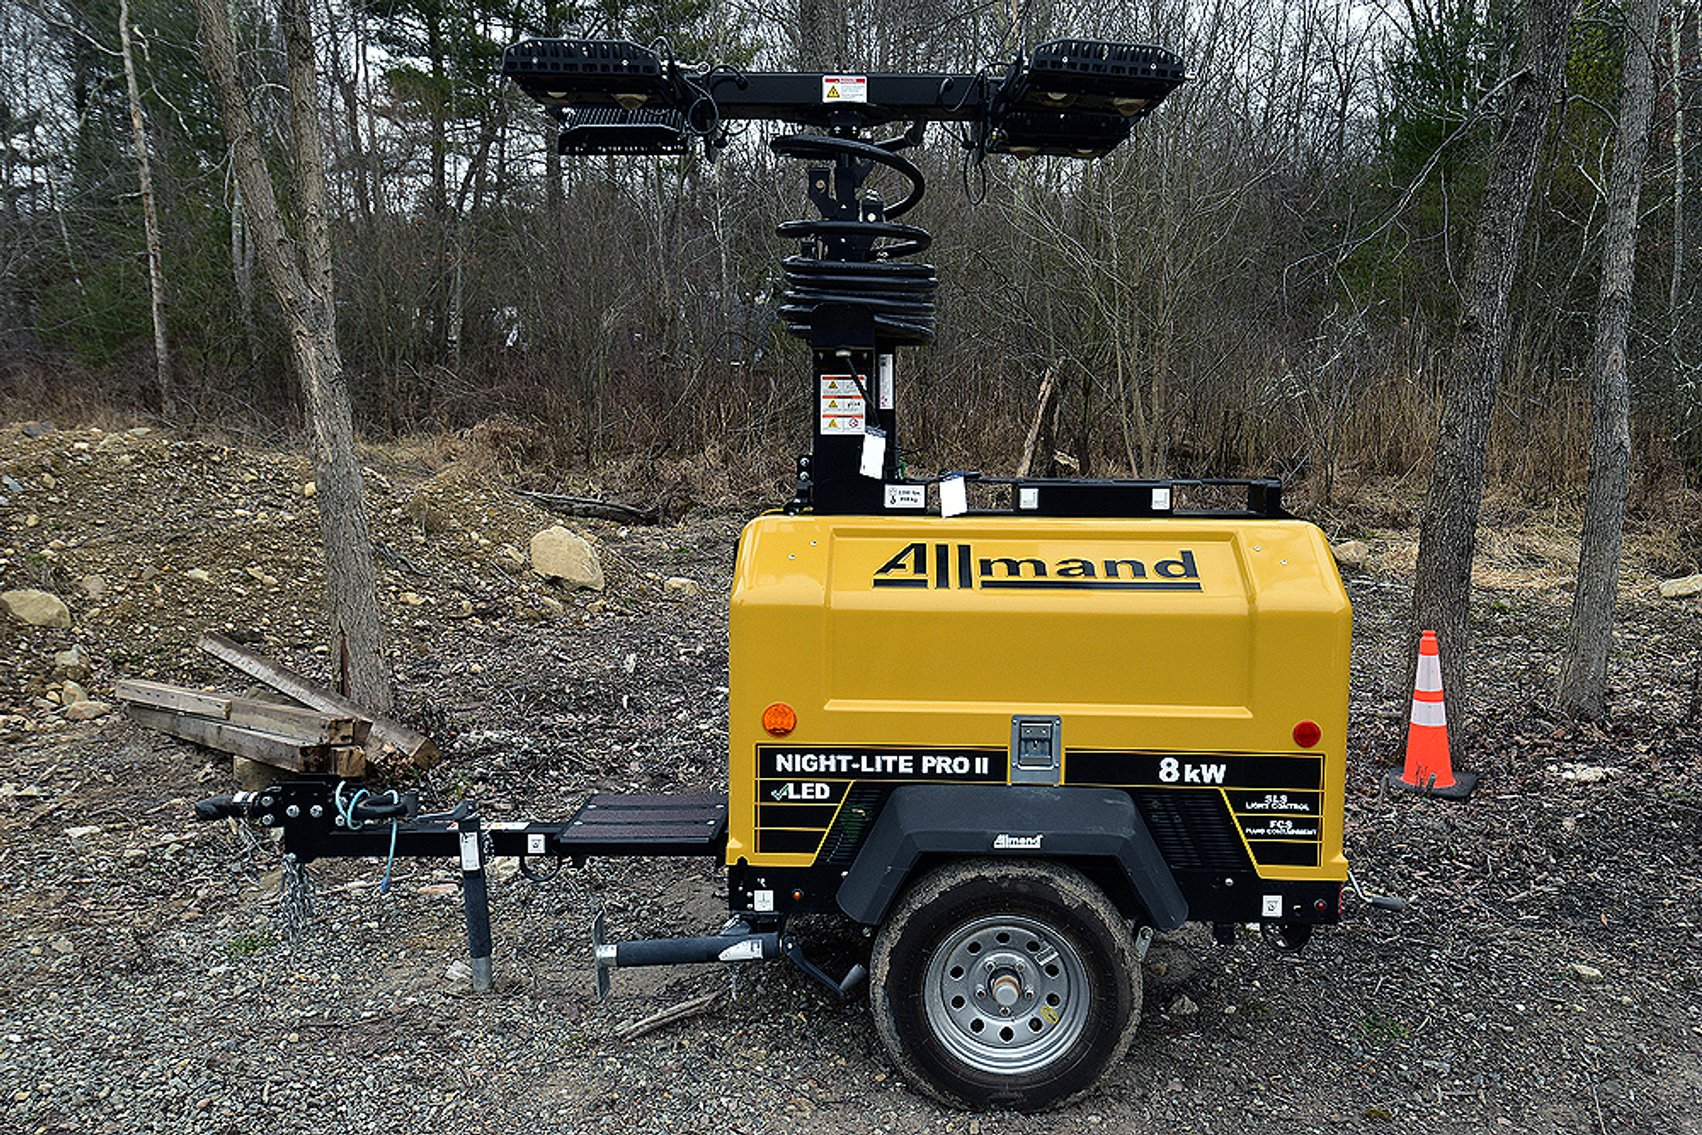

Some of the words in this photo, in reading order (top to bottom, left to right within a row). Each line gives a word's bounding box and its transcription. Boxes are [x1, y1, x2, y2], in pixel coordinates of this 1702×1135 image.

[873, 543, 1203, 591] Allmand
[775, 754, 914, 774] NIGHT-LITE
[921, 755, 970, 774] PRO
[975, 757, 989, 774] II
[1159, 757, 1180, 783] 8
[1184, 764, 1227, 784] kW
[788, 783, 830, 800] LED
[1264, 794, 1288, 804] SLS
[1271, 802, 1310, 811] CONTROL
[1269, 820, 1293, 829] FCS
[993, 833, 1043, 849] Allmand
